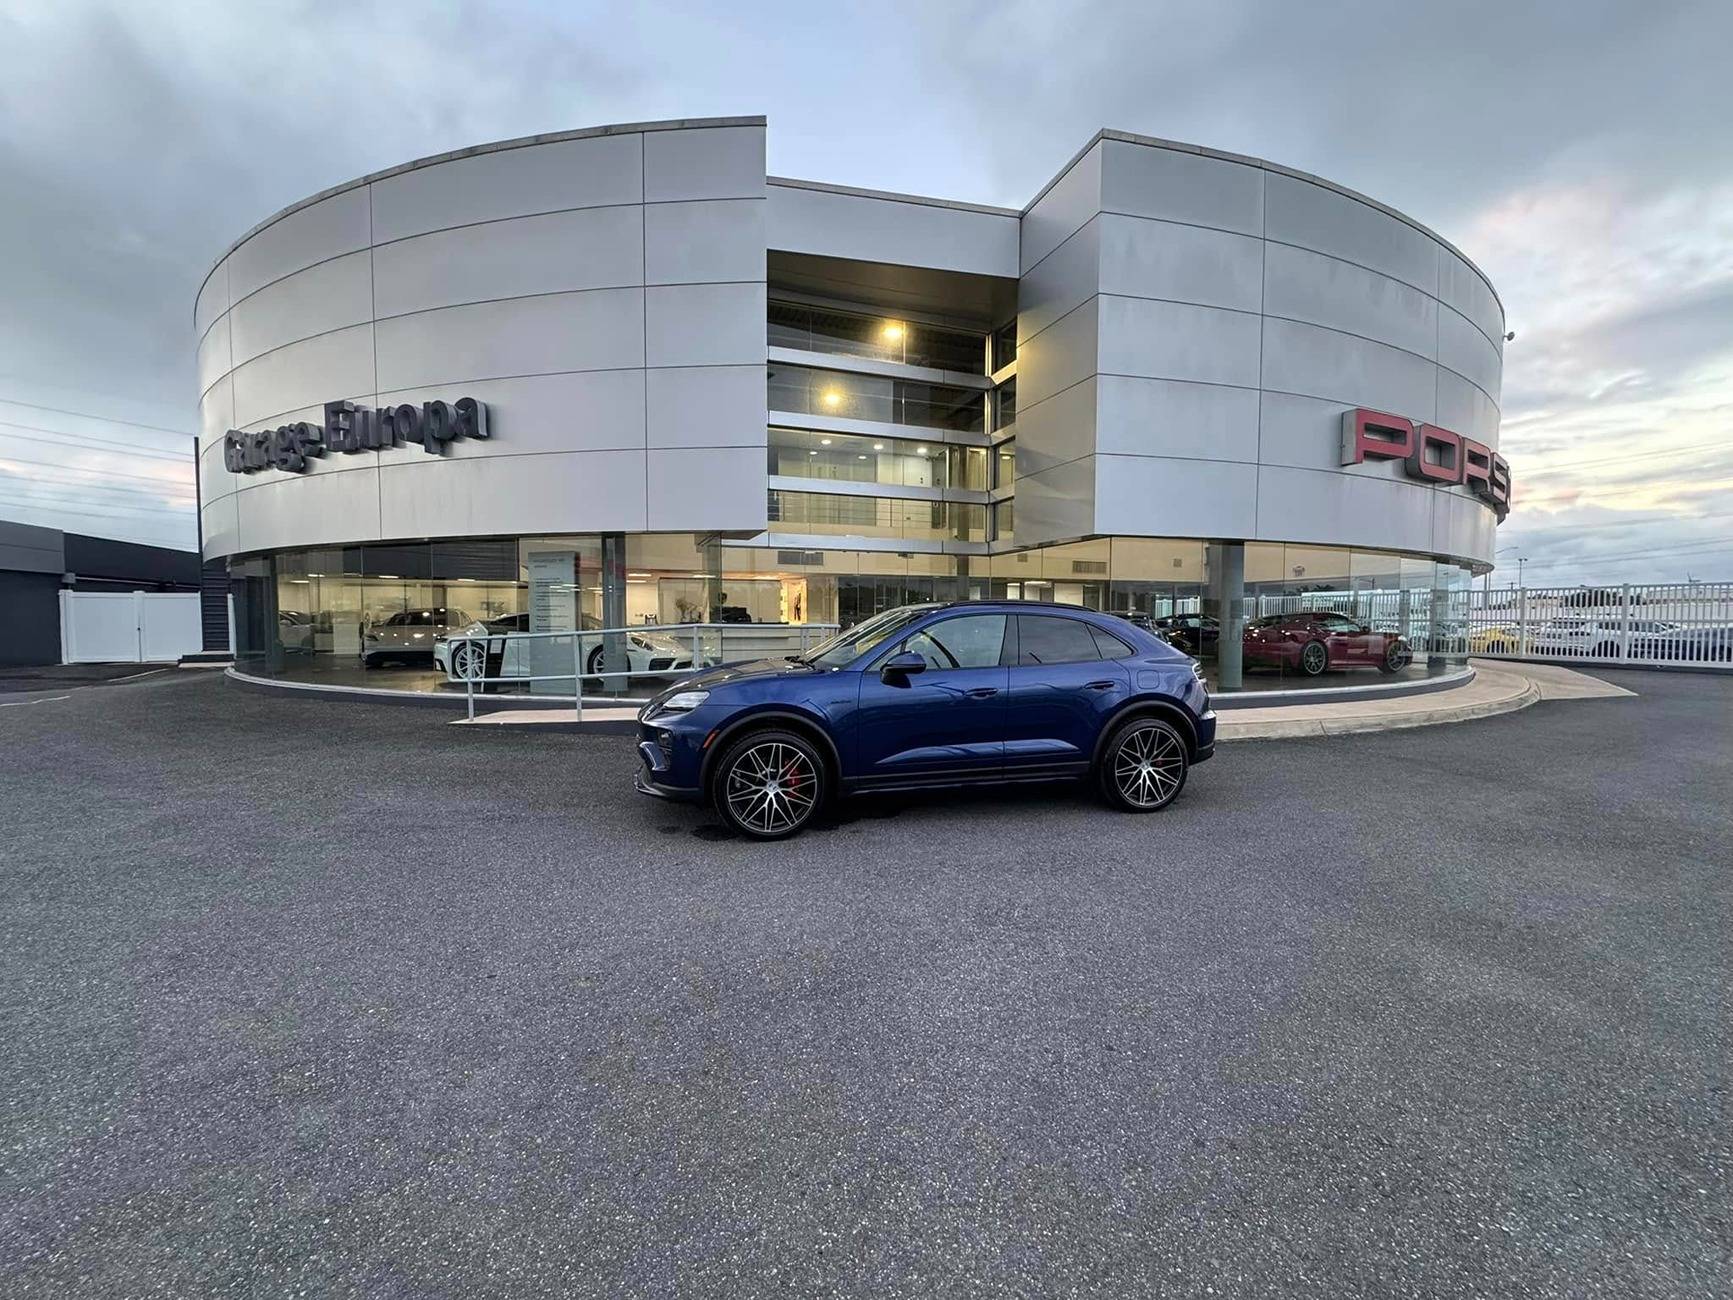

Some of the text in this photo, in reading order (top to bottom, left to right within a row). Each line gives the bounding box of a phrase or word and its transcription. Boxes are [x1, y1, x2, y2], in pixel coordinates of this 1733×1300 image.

[224, 396, 490, 474] Garage Europa
[1342, 406, 1511, 514] PORS
